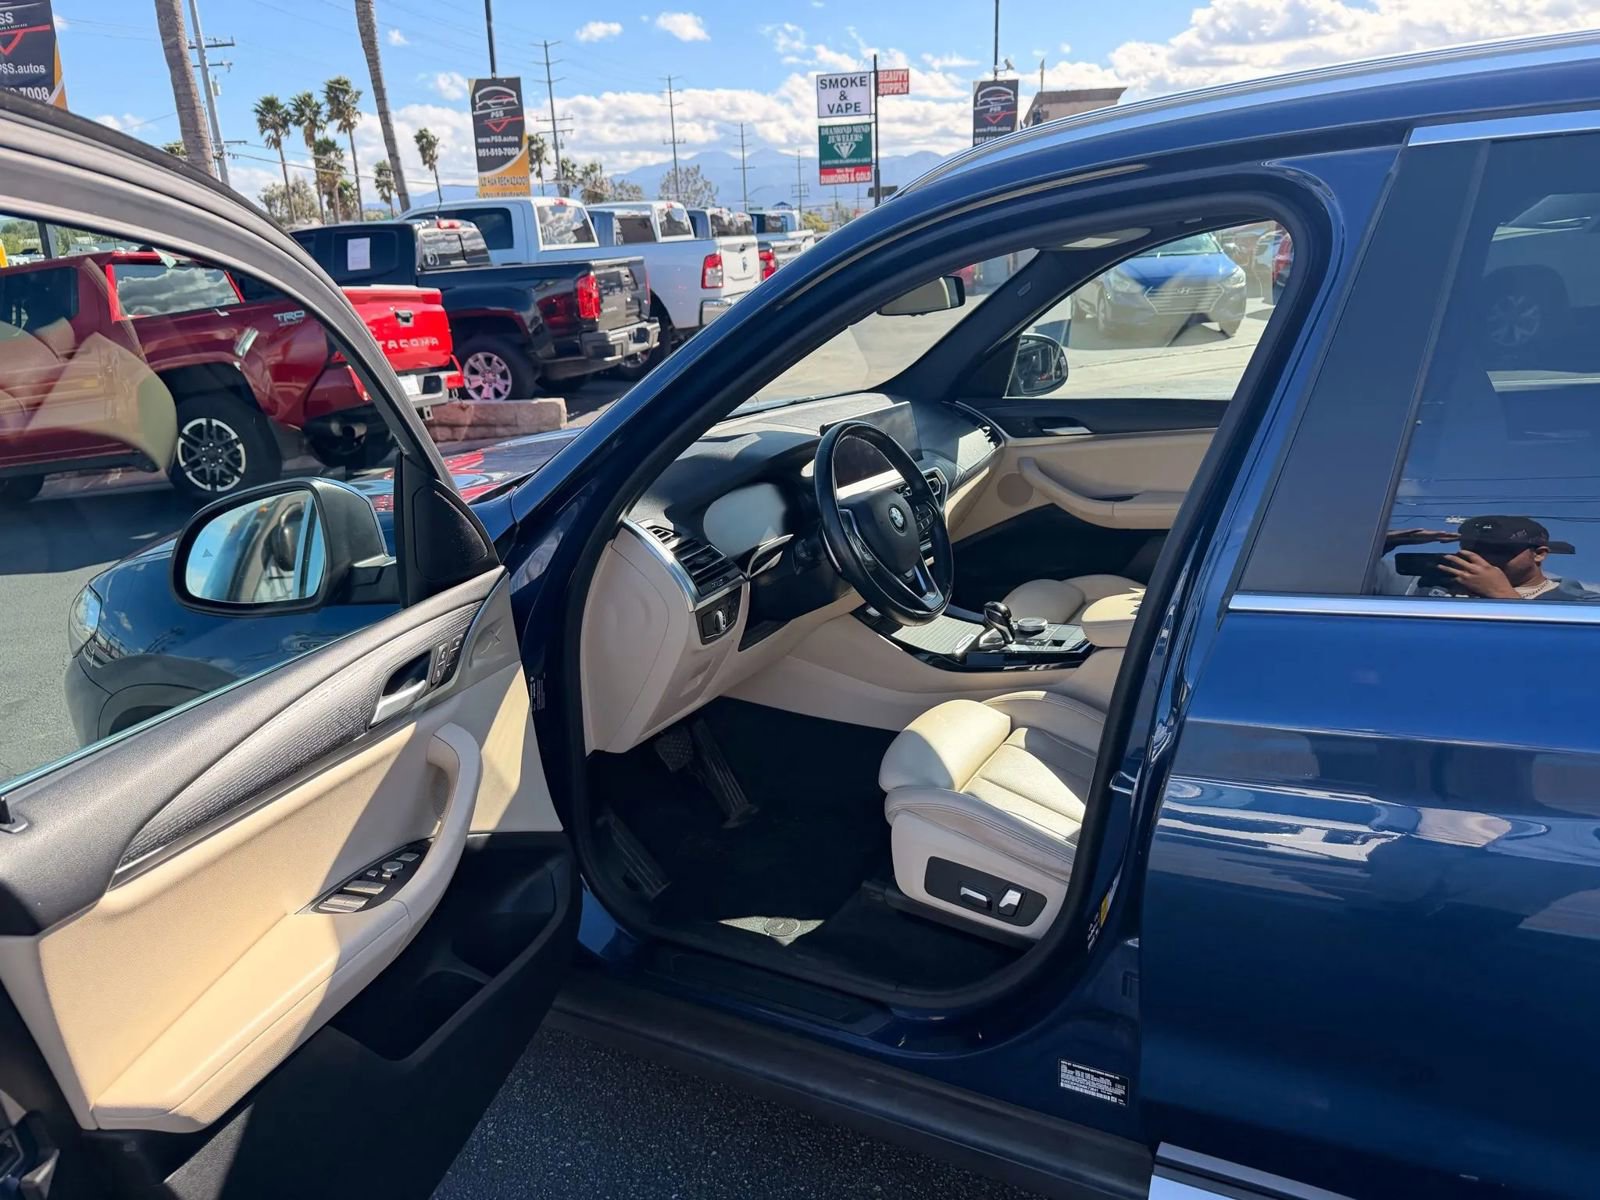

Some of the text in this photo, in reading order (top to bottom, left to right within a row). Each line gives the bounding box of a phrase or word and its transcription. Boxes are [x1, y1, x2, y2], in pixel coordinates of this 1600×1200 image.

[820, 76, 868, 90] SMOKE
[839, 90, 848, 101] &
[827, 102, 862, 115] VAPE
[827, 134, 863, 144] JEWELERS
[377, 336, 439, 350] TACOMA
